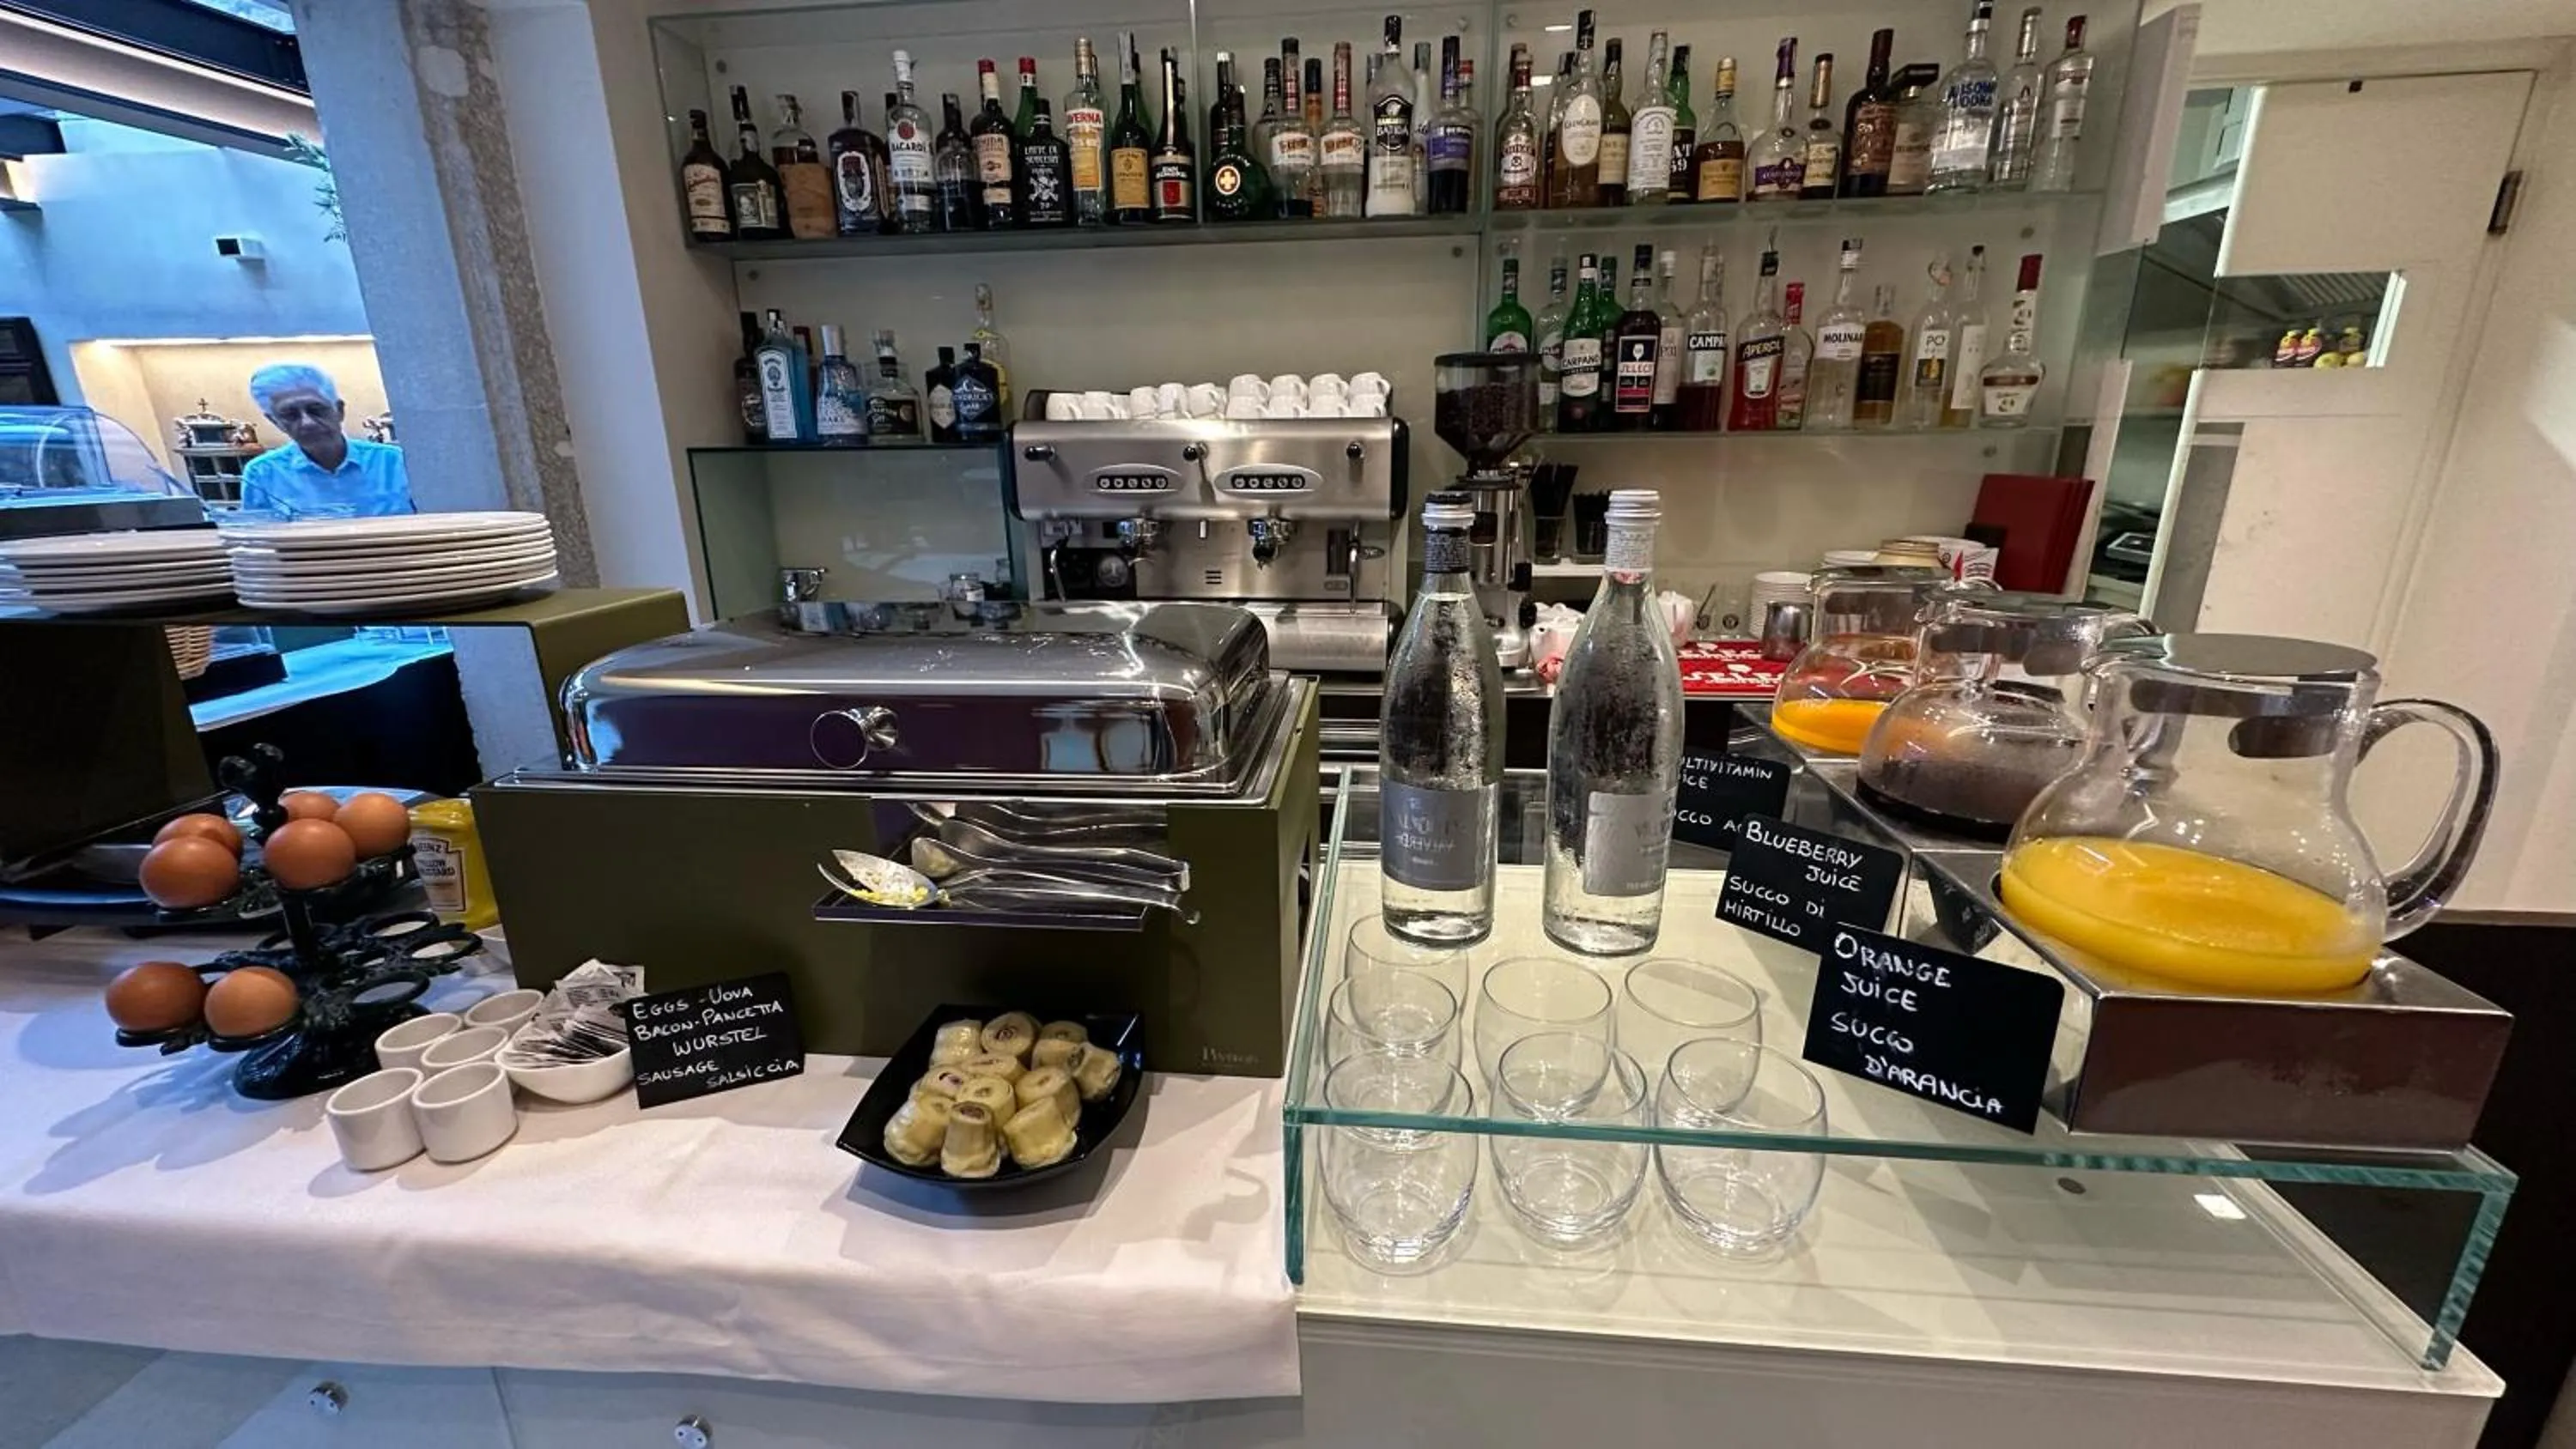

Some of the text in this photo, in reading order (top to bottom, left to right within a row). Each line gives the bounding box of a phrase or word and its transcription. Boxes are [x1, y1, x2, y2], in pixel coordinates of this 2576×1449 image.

[1672, 143, 1692, 158] AT
[1743, 339, 1783, 359] APEROL
[1680, 770, 1709, 789] ICE
[1681, 756, 1772, 779] LTIVITAMIN
[1674, 809, 1712, 825] CCO
[1746, 821, 1862, 869] BLUEBERRY
[1805, 864, 1862, 892] JUICE
[1729, 876, 1826, 919] SUCCO DI
[1834, 931, 1952, 988] ORANGE
[632, 997, 690, 1020] EGGS
[708, 985, 754, 1005] UOVA
[1840, 971, 1919, 1012] JUICE
[672, 1026, 769, 1057] WURSTEL
[1830, 1011, 1914, 1052] SUCCO
[637, 1060, 720, 1086] SAUSAGE
[706, 1058, 800, 1088] SALSICCIA
[1865, 1054, 2005, 1114] D'ARANCIA
